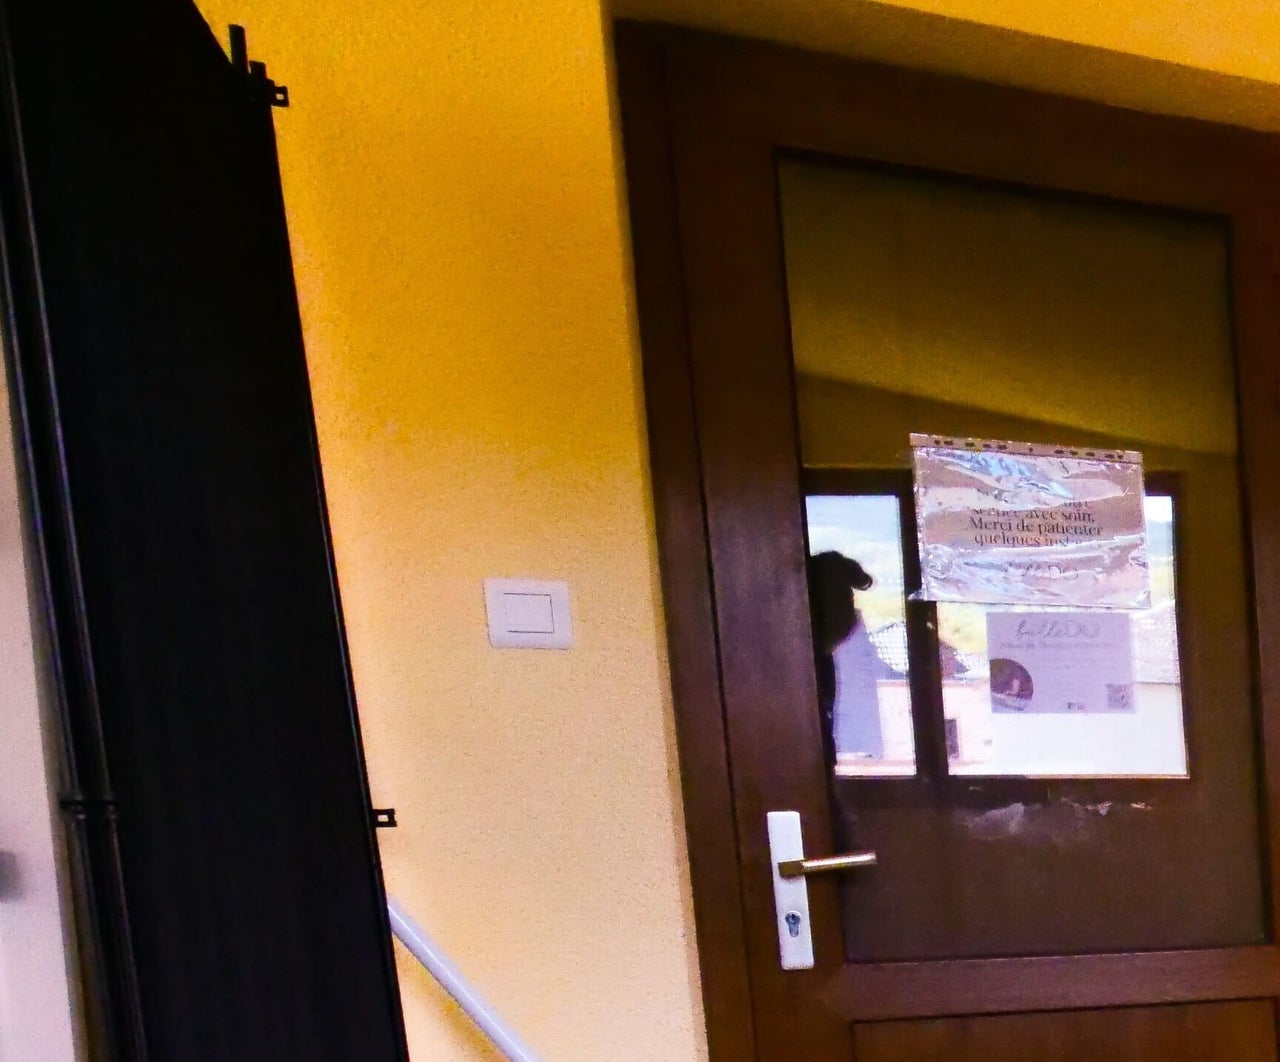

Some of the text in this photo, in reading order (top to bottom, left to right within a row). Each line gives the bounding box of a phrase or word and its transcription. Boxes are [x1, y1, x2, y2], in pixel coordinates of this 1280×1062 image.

[1025, 509, 1057, 520] avec
[970, 516, 1103, 537] Merci de patienter
[974, 531, 1042, 548] quelques
